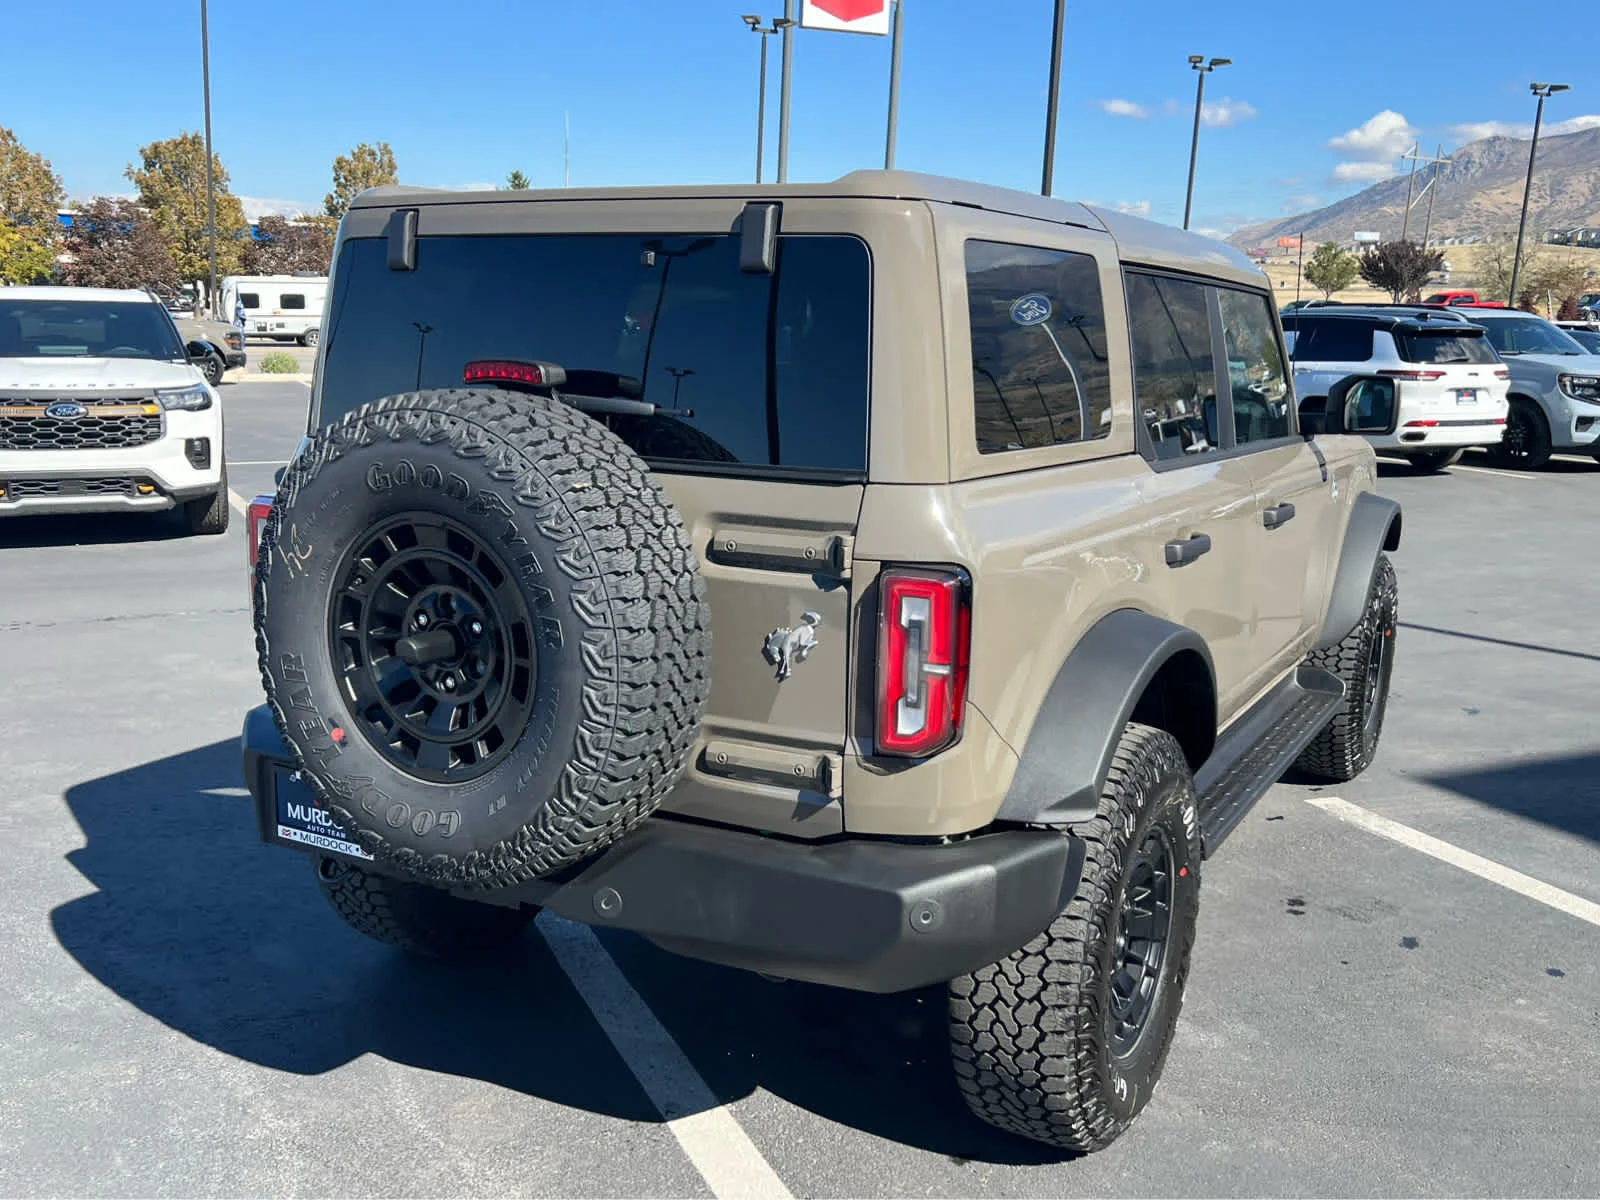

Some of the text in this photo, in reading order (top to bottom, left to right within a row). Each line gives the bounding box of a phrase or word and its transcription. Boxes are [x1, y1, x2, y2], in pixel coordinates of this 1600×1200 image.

[366, 458, 565, 650] GOODYEAR
[280, 651, 462, 838] GOODYEAR
[287, 801, 344, 830] MURD
[300, 832, 353, 854] MURDOCK
[307, 824, 347, 839] AUTO TEAM
